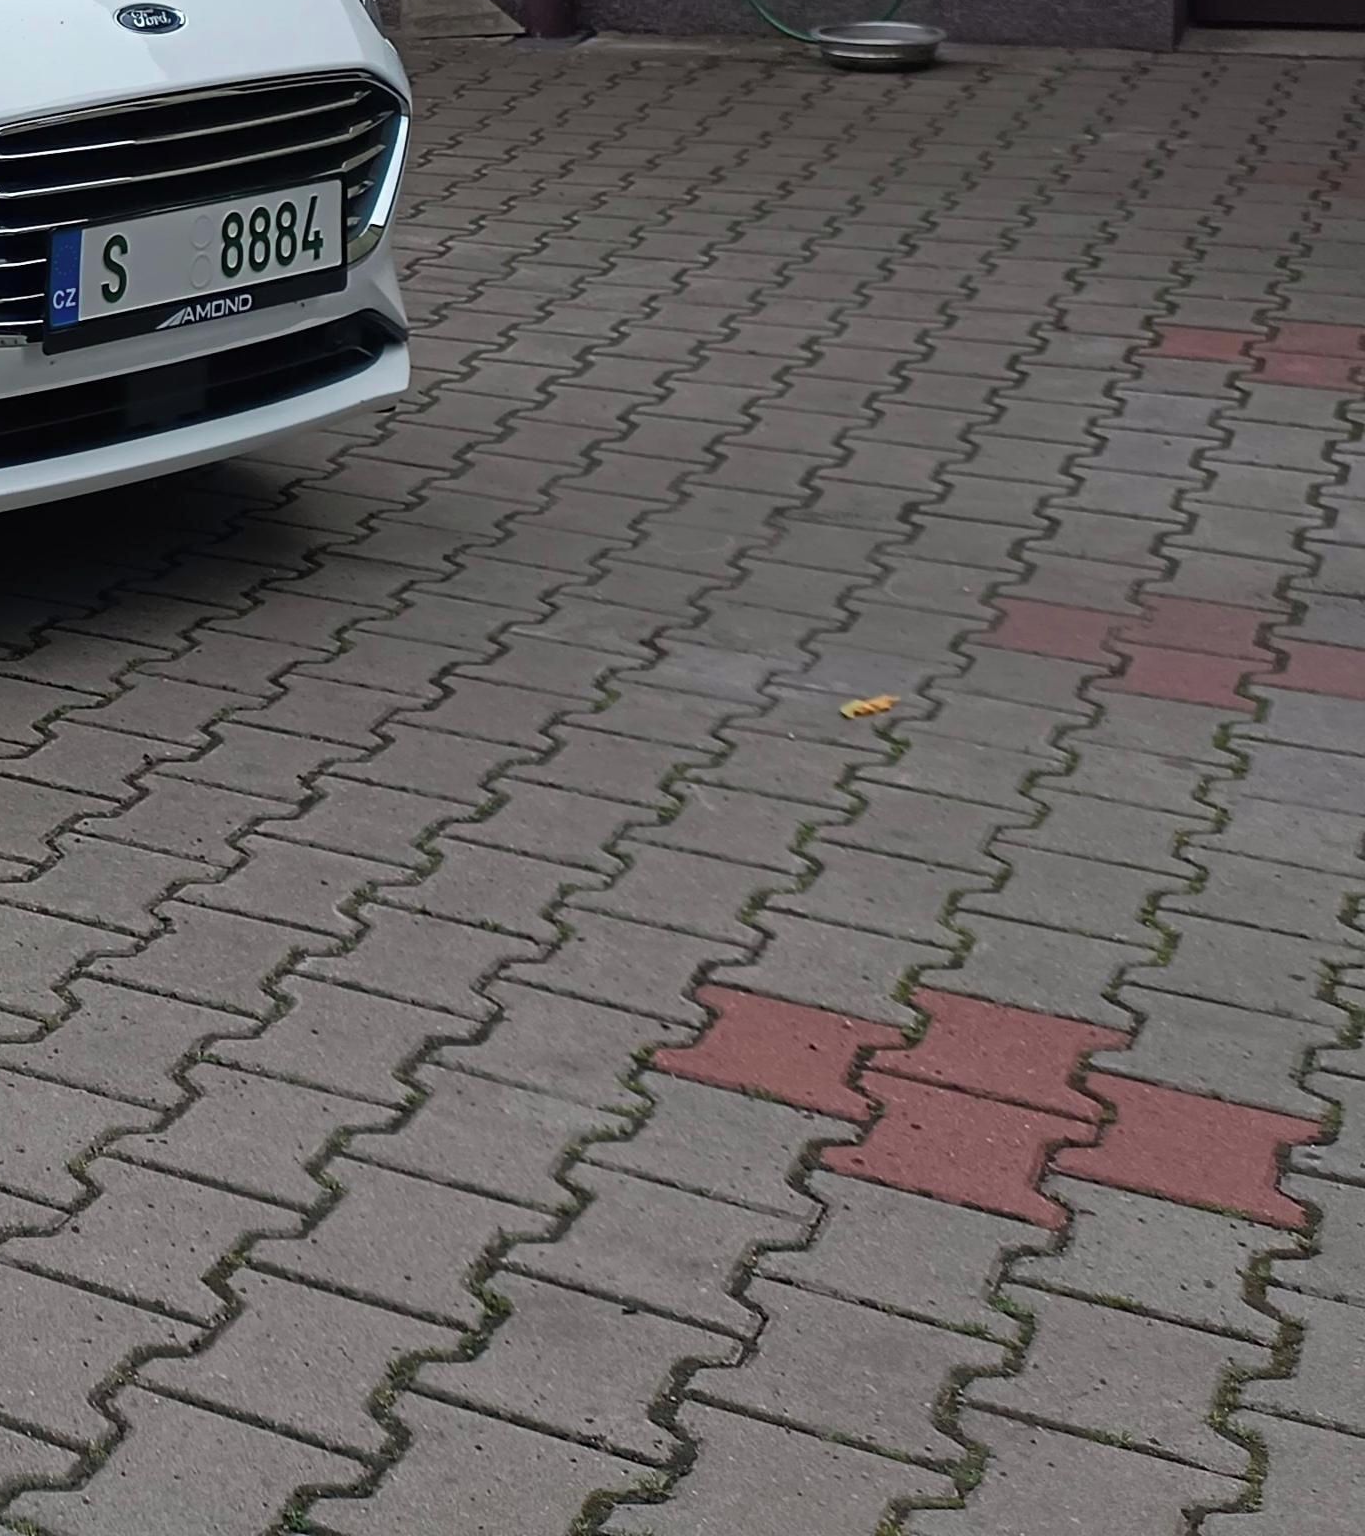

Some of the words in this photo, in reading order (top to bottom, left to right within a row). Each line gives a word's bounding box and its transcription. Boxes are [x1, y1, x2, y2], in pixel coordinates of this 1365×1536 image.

[131, 9, 171, 27] Ford
[101, 234, 128, 302] S
[221, 195, 324, 277] 8884
[53, 289, 76, 309] CZ
[181, 294, 252, 324] AMOND
